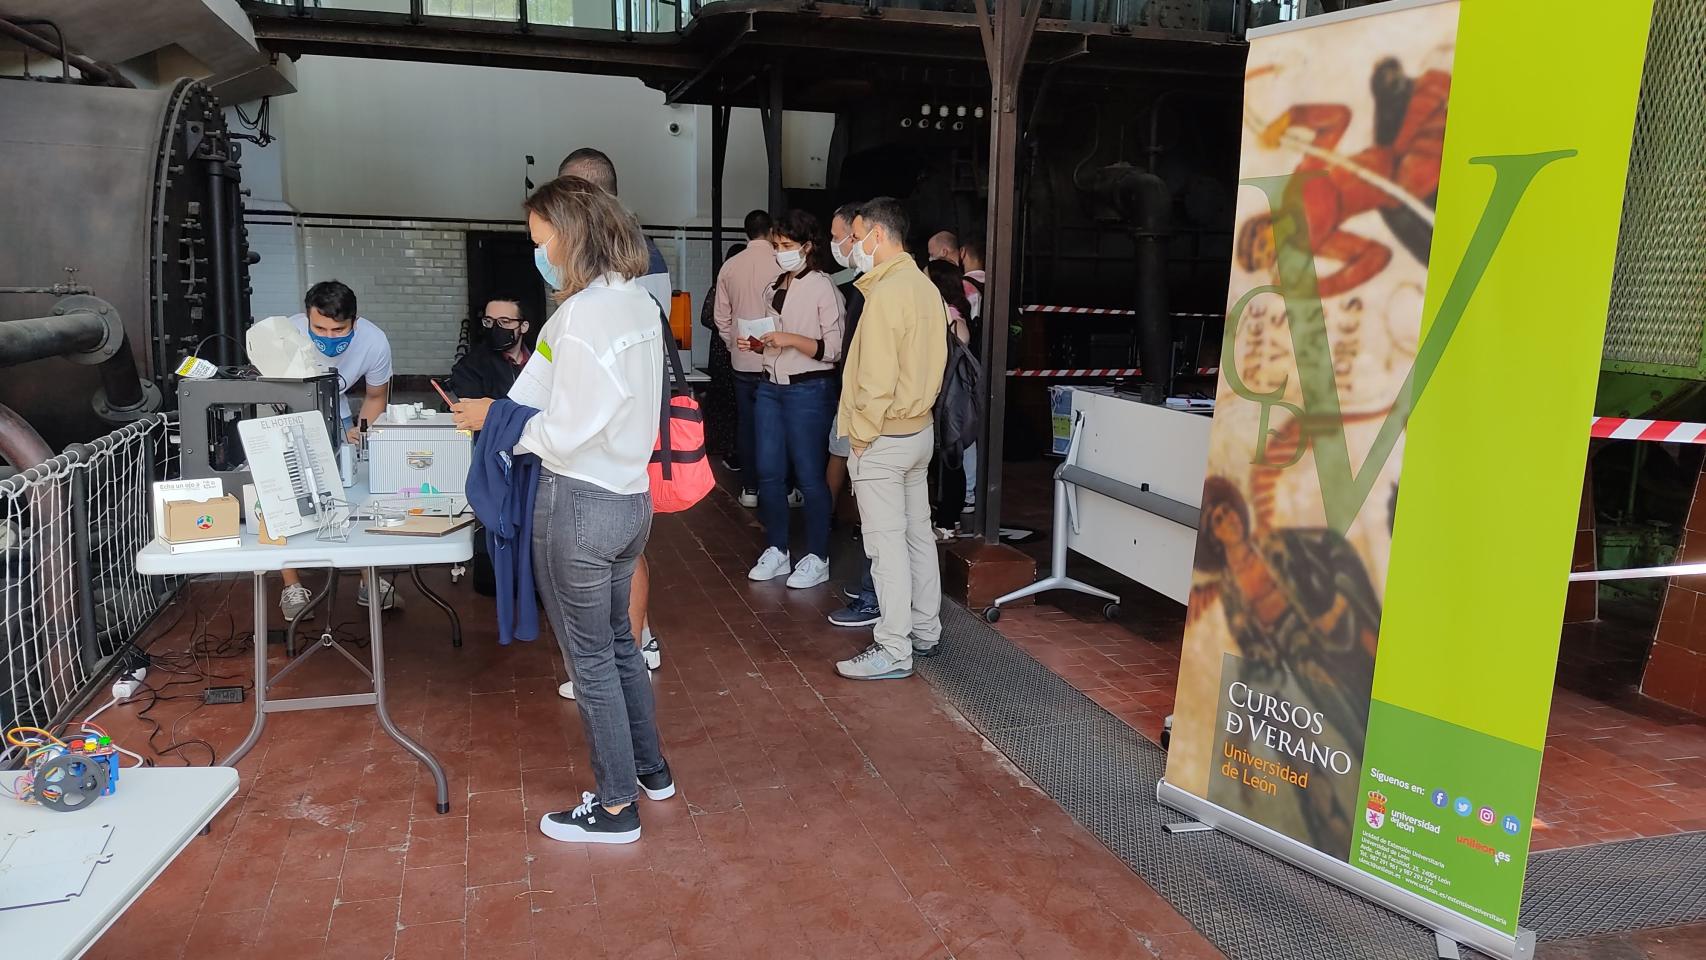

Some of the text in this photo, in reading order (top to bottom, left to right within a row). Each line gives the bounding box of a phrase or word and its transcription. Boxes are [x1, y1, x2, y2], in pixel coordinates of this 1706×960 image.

[1228, 681, 1324, 735] CURSOS
[1247, 714, 1352, 775] VERANO
[1221, 762, 1277, 796] de León
[1223, 741, 1309, 788] Universidad
[1370, 767, 1425, 796] Síguenos en:
[1390, 809, 1441, 834] universidad
[1396, 818, 1415, 834] león
